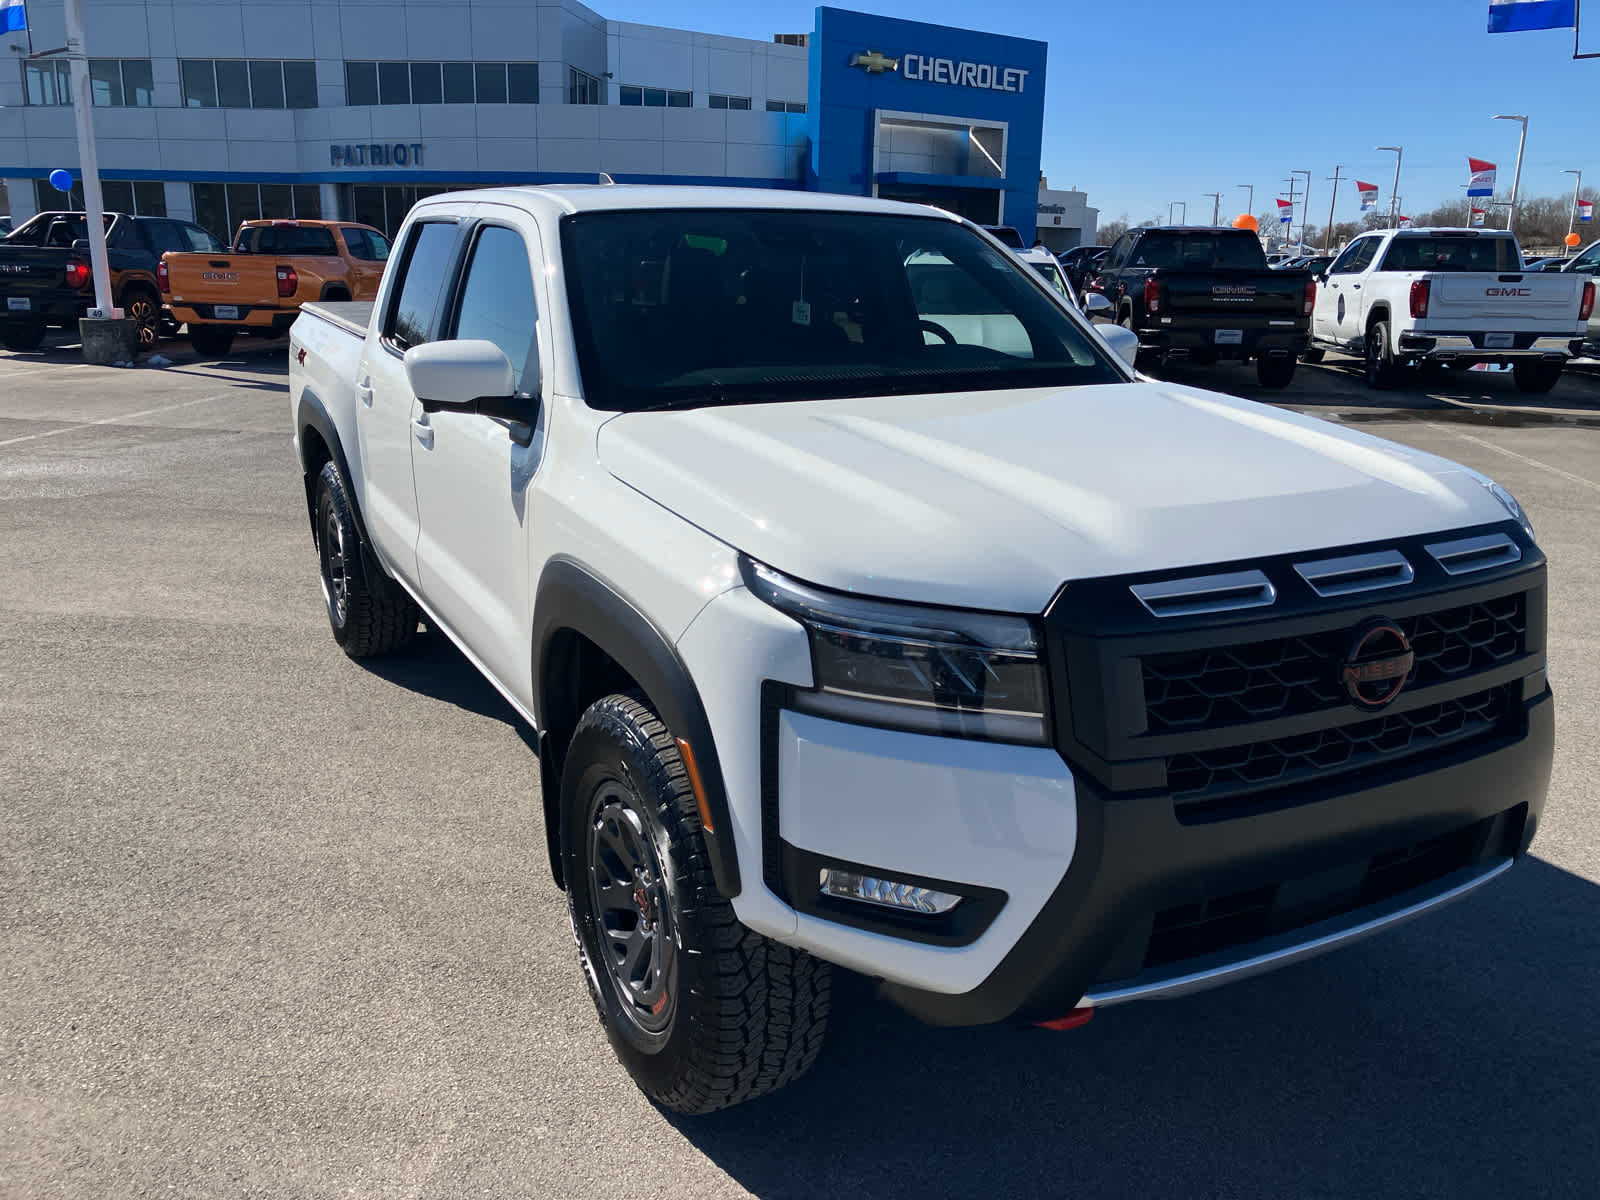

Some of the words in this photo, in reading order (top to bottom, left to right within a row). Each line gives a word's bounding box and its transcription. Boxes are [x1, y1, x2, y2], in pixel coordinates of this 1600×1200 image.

[904, 54, 1028, 92] CHEVROLET
[330, 143, 423, 166] PATRIOT
[1485, 287, 1532, 297] GMC
[1343, 654, 1412, 682] NISS
